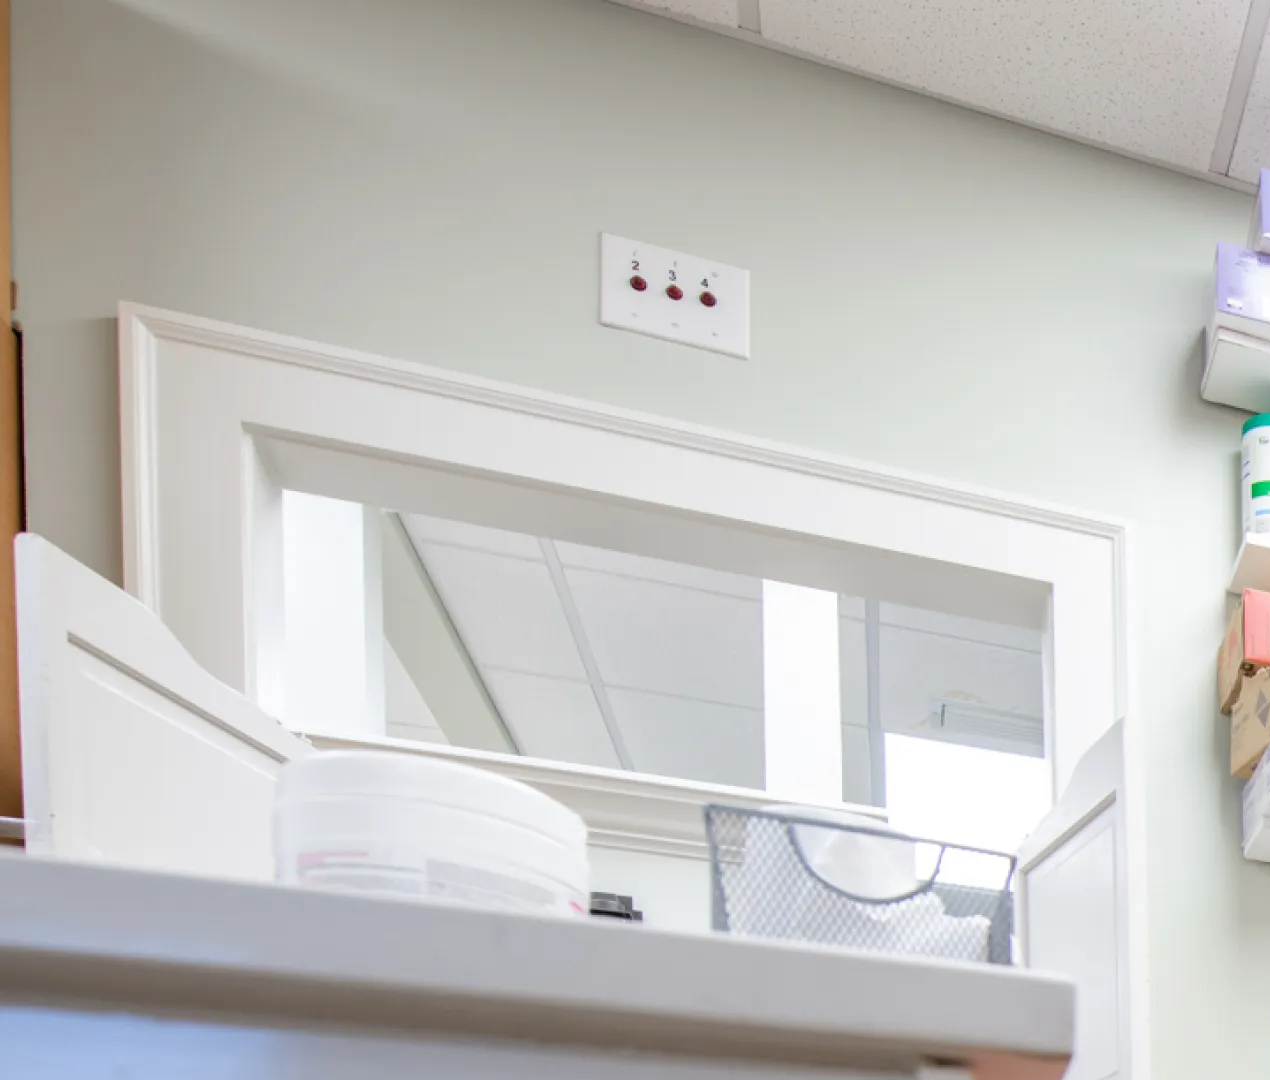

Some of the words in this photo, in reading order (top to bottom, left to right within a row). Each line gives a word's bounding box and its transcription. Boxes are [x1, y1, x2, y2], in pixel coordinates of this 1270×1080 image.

[632, 261, 640, 270] 2
[669, 270, 677, 281] 3
[700, 279, 709, 288] 4
